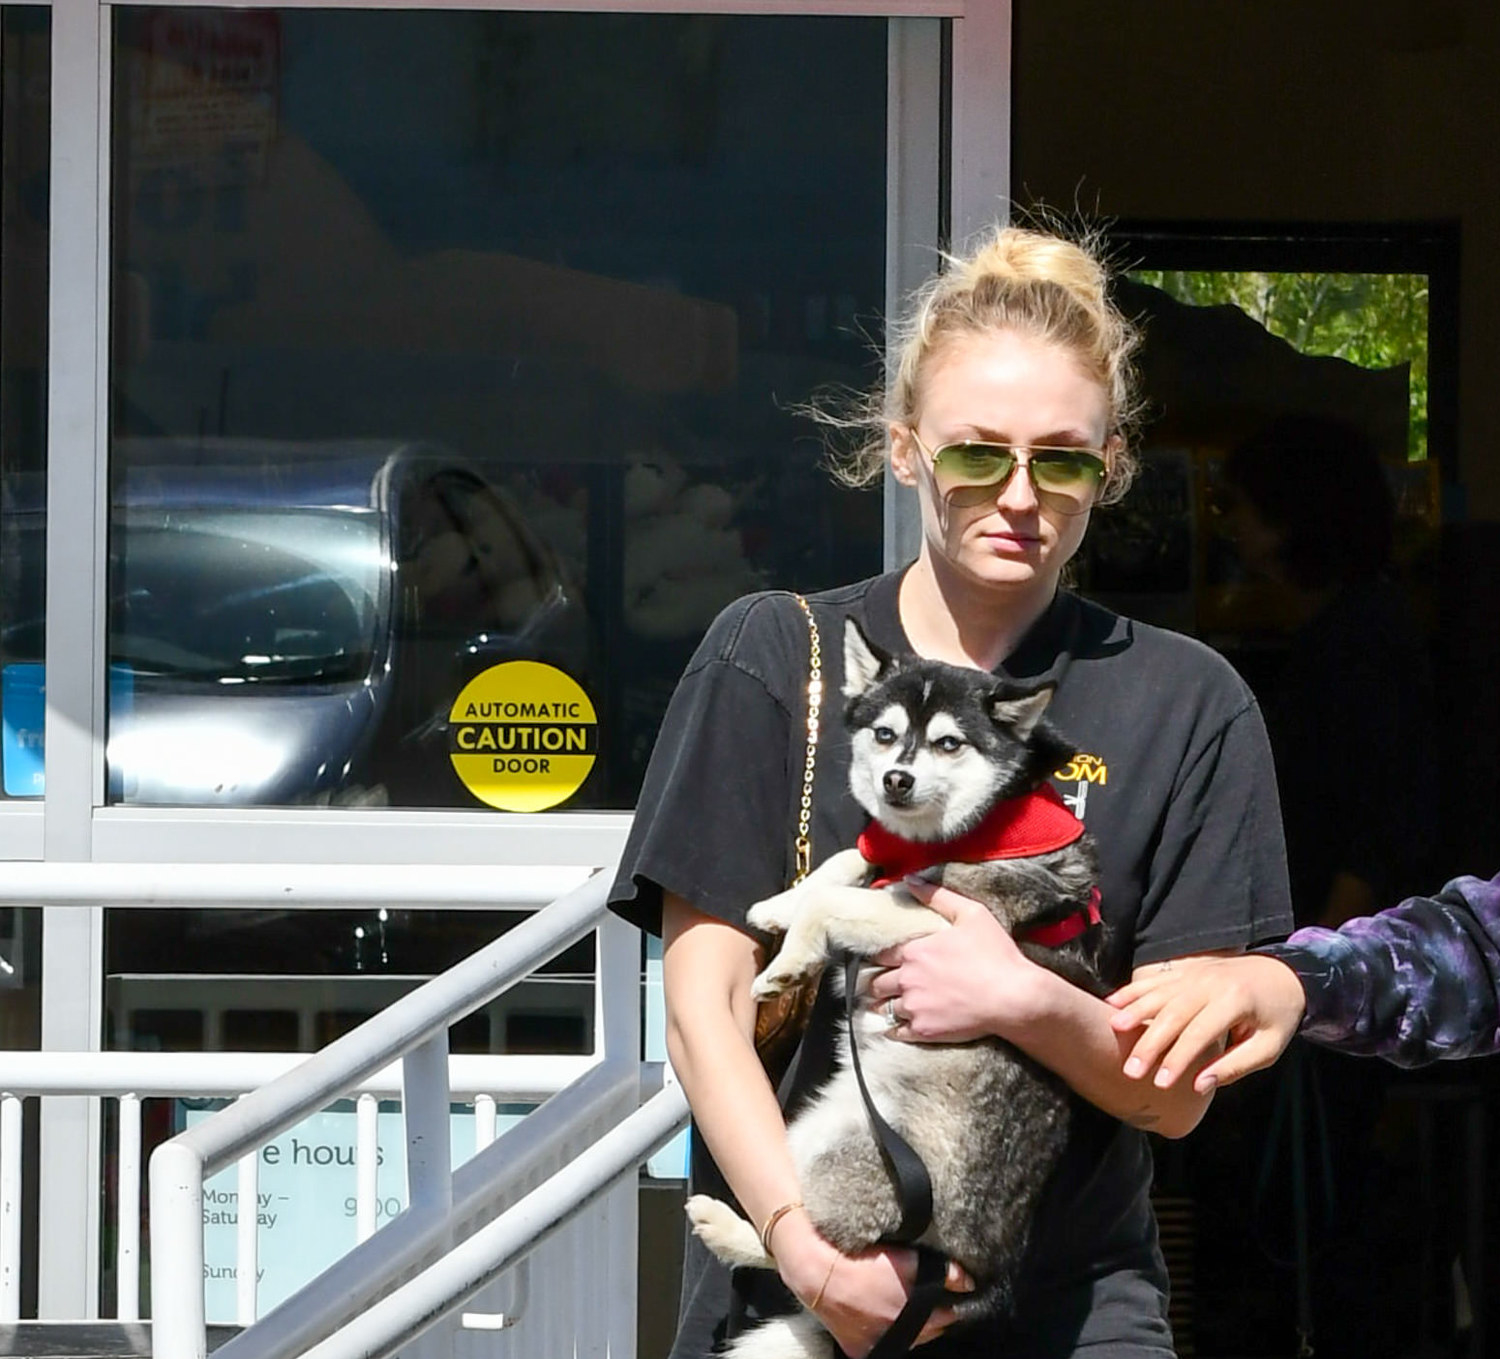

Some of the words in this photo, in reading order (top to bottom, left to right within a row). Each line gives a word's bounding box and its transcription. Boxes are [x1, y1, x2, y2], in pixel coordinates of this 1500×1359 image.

[465, 702, 580, 718] AUTOMATIC
[457, 726, 587, 751] CAUTION
[493, 759, 550, 773] DOOR
[291, 1139, 384, 1166] hous
[202, 1189, 272, 1210] Monay
[202, 1208, 278, 1229] Satuay
